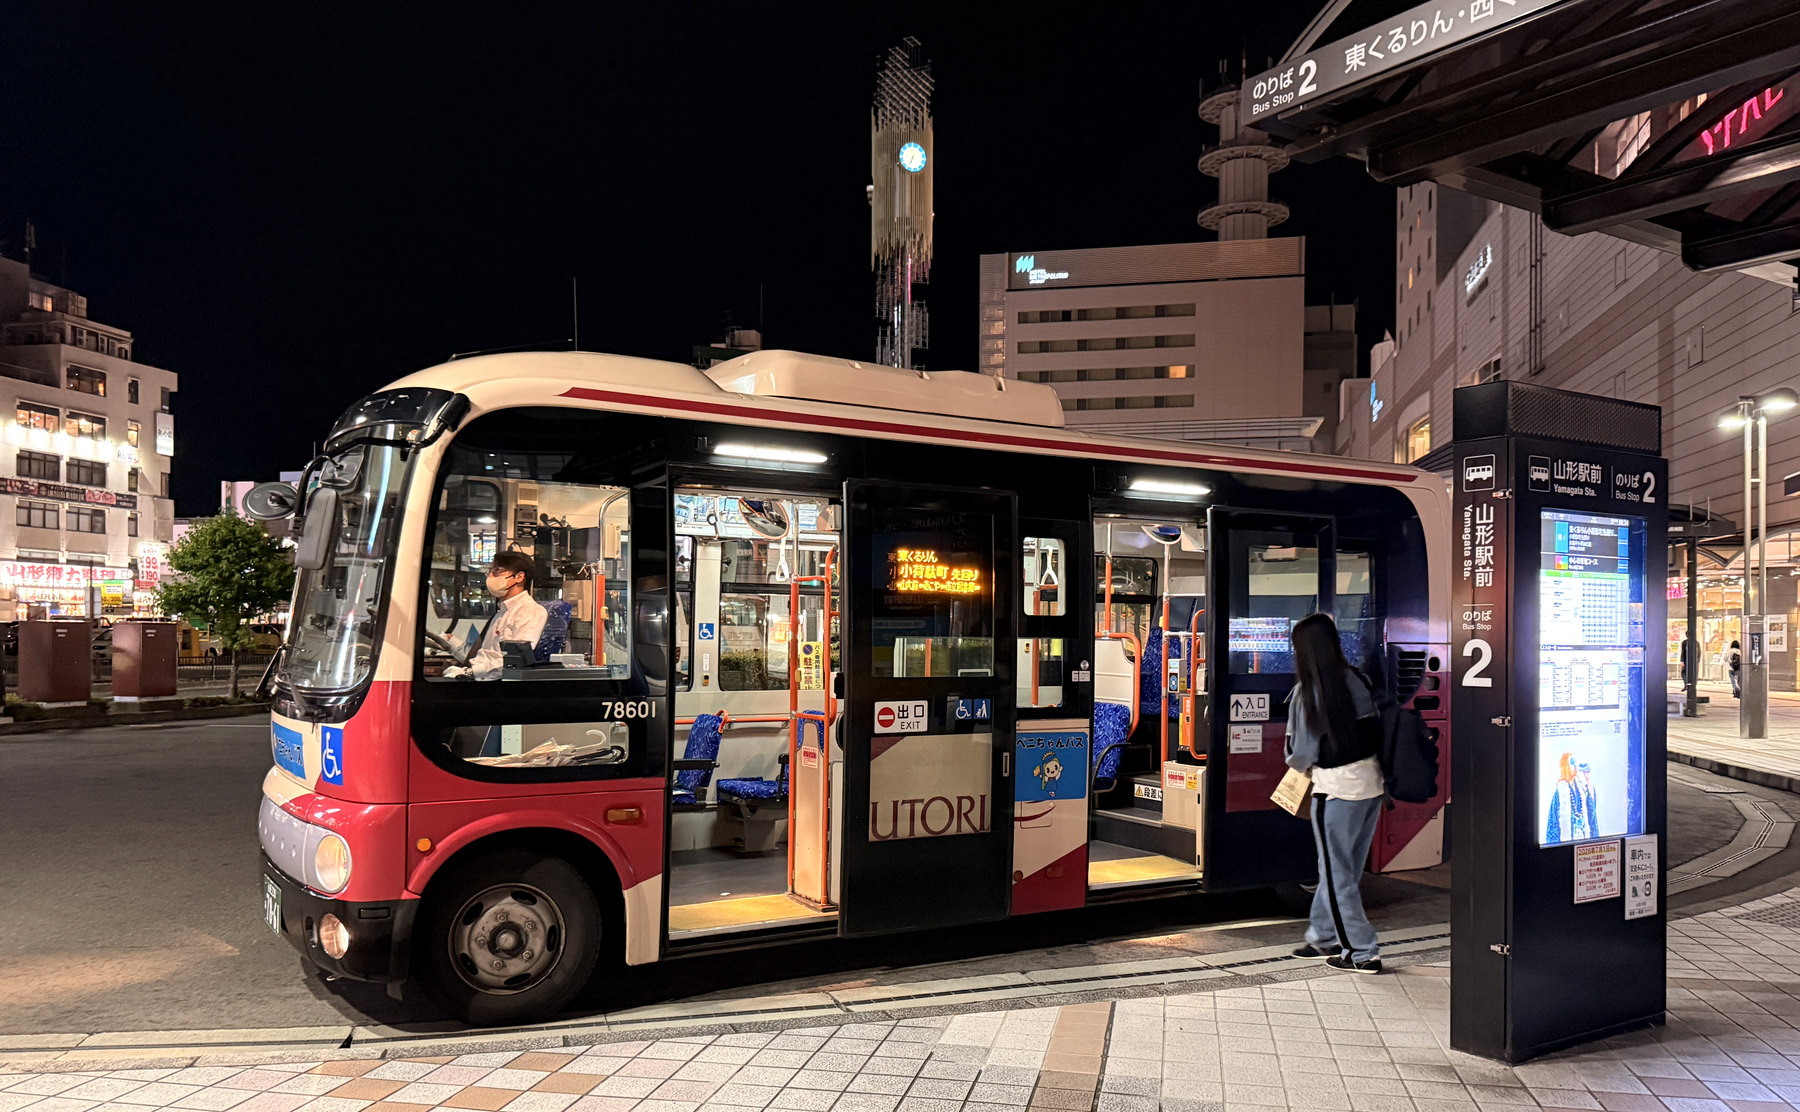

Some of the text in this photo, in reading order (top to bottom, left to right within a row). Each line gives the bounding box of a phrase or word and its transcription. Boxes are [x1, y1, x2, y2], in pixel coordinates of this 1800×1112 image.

[1344, 0, 1517, 74] 東くるりん・西
[1252, 68, 1294, 100] のりば
[1298, 59, 1318, 97] 2
[1252, 91, 1295, 116] Bus Stop
[1553, 459, 1603, 484] 山形駅前
[1615, 473, 1641, 488] のりば
[1643, 471, 1656, 504] 2
[1553, 484, 1597, 497] Yamagata Sta.
[1615, 491, 1640, 502] Bus Stop
[1463, 504, 1473, 581] Yamagata Sta.
[1475, 503, 1494, 588] 山形駅前
[897, 549, 938, 563] 東くるりん
[900, 564, 979, 581] 小荷駄町 先回り
[1463, 610, 1492, 622] のりば
[1476, 623, 1492, 631] Stop
[1461, 638, 1493, 688] 2
[601, 701, 656, 719] 78601
[897, 704, 925, 718] 出口
[1245, 697, 1266, 709] 入口
[1242, 711, 1268, 719] ENTRANCE
[900, 721, 921, 730] EXIT
[1016, 737, 1084, 749] ベニちゃんバス
[871, 794, 989, 841] UTORI
